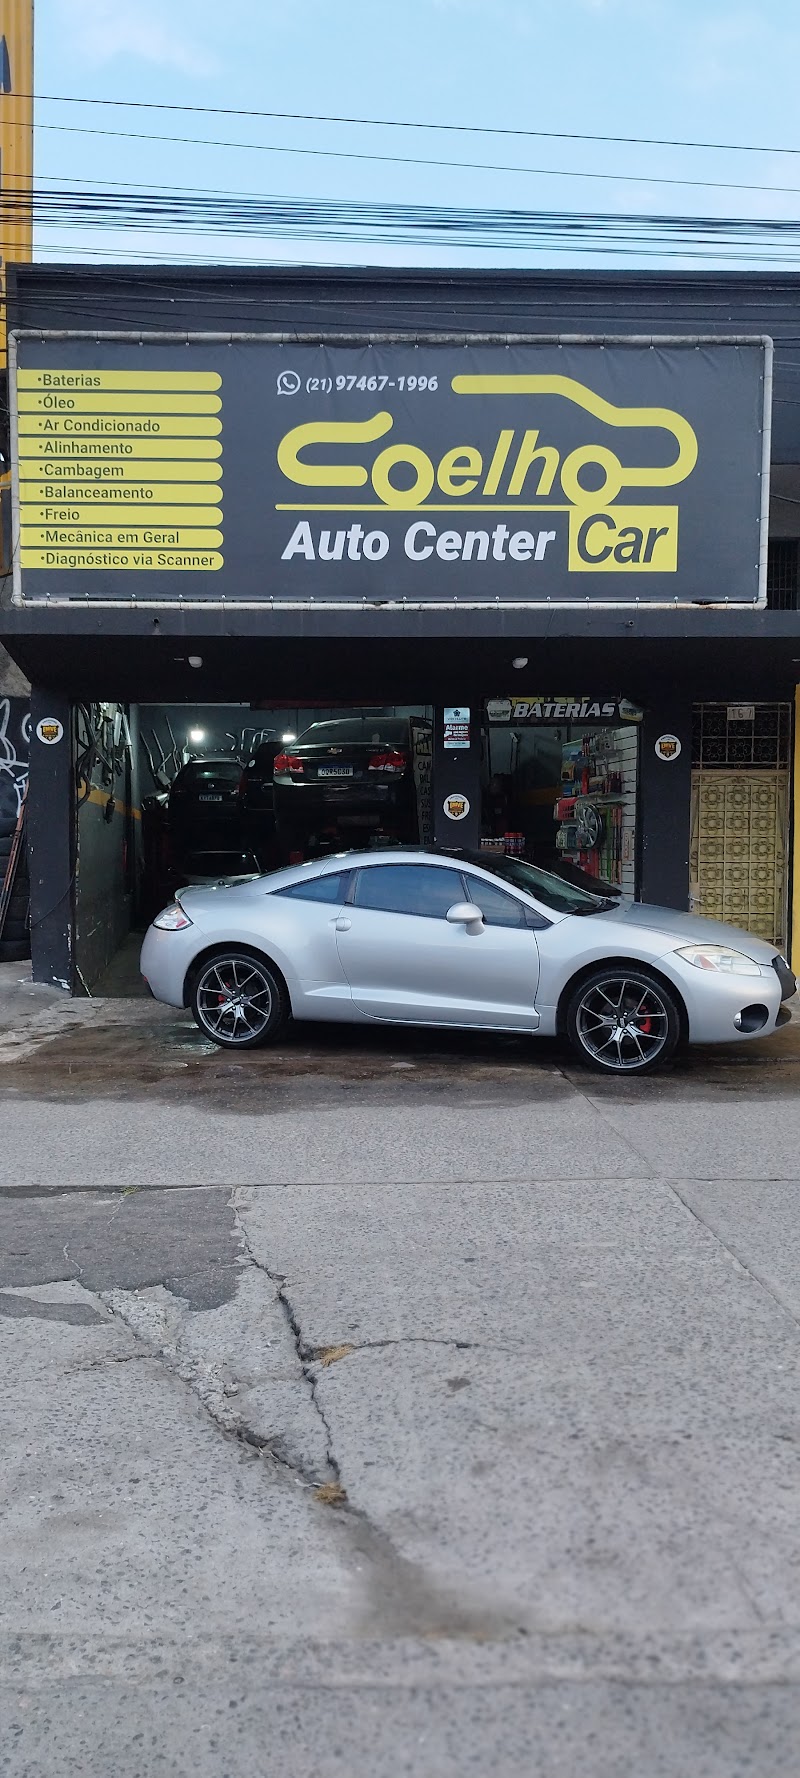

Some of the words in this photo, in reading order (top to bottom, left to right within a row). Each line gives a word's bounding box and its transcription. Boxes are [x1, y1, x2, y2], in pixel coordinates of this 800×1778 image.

[43, 374, 101, 387] Baterias
[306, 377, 333, 393] (21)
[335, 374, 439, 392] 97467-1996
[43, 394, 75, 408] Óleo
[43, 419, 59, 431] Ar
[64, 419, 160, 432] Condicionado
[44, 441, 133, 454] Alinhamento
[277, 411, 623, 507] Coelho
[44, 464, 124, 479] Cambagem
[45, 486, 153, 499] Balanceamento
[45, 508, 80, 521] Freio
[45, 530, 113, 543] Mecânica
[117, 533, 138, 543] em
[143, 531, 180, 544] Geral
[281, 521, 390, 561] Auto
[403, 520, 556, 561] Center
[576, 513, 669, 564] Car
[46, 552, 129, 567] Diagnóstico
[132, 554, 153, 565] via
[157, 554, 215, 566] Scanner
[513, 702, 616, 718] BATERIAS
